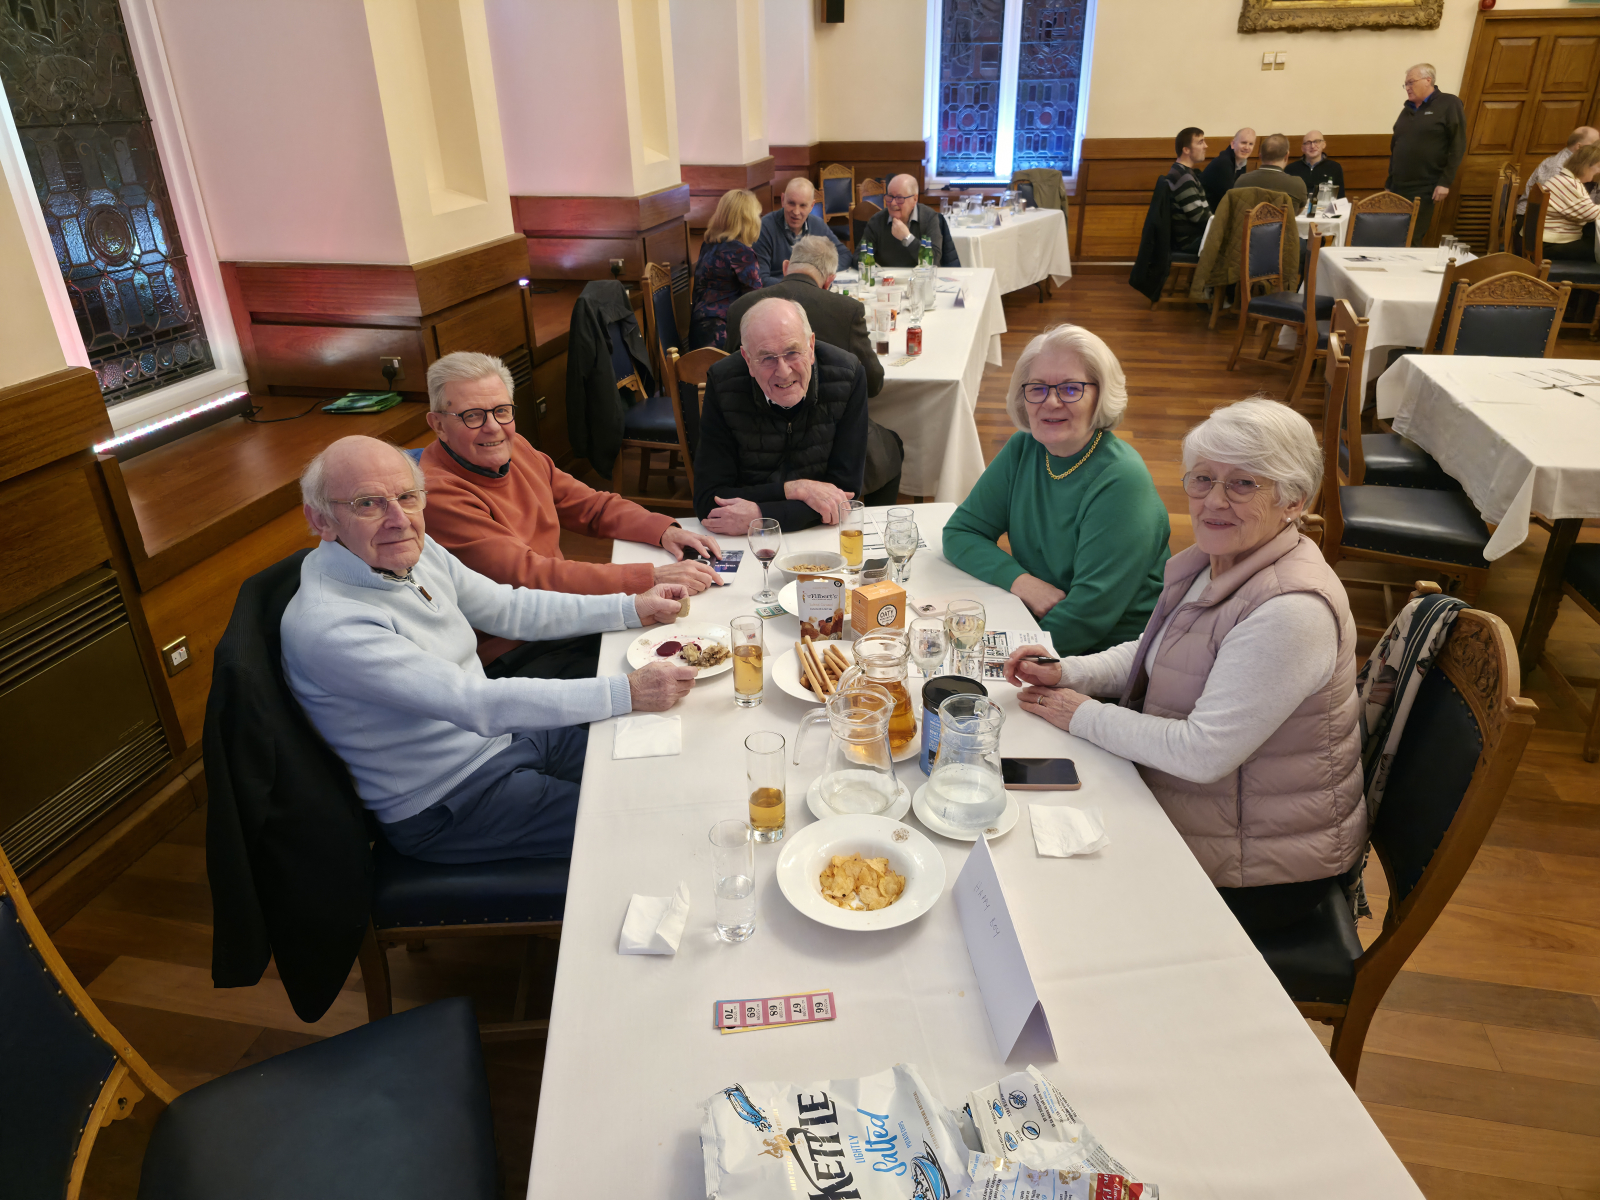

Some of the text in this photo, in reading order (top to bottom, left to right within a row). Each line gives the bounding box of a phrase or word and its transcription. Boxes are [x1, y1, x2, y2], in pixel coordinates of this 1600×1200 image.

[725, 1008, 734, 1020] 70
[747, 1007, 756, 1018] 69
[769, 1005, 778, 1016] 68
[792, 1003, 802, 1014] 67
[815, 1002, 824, 1014] 66
[898, 1121, 913, 1149] POTATO CHIPS
[786, 1090, 863, 1200] KETTLE
[856, 1108, 908, 1177] Salted
[848, 1135, 866, 1164] LIGHTLY
